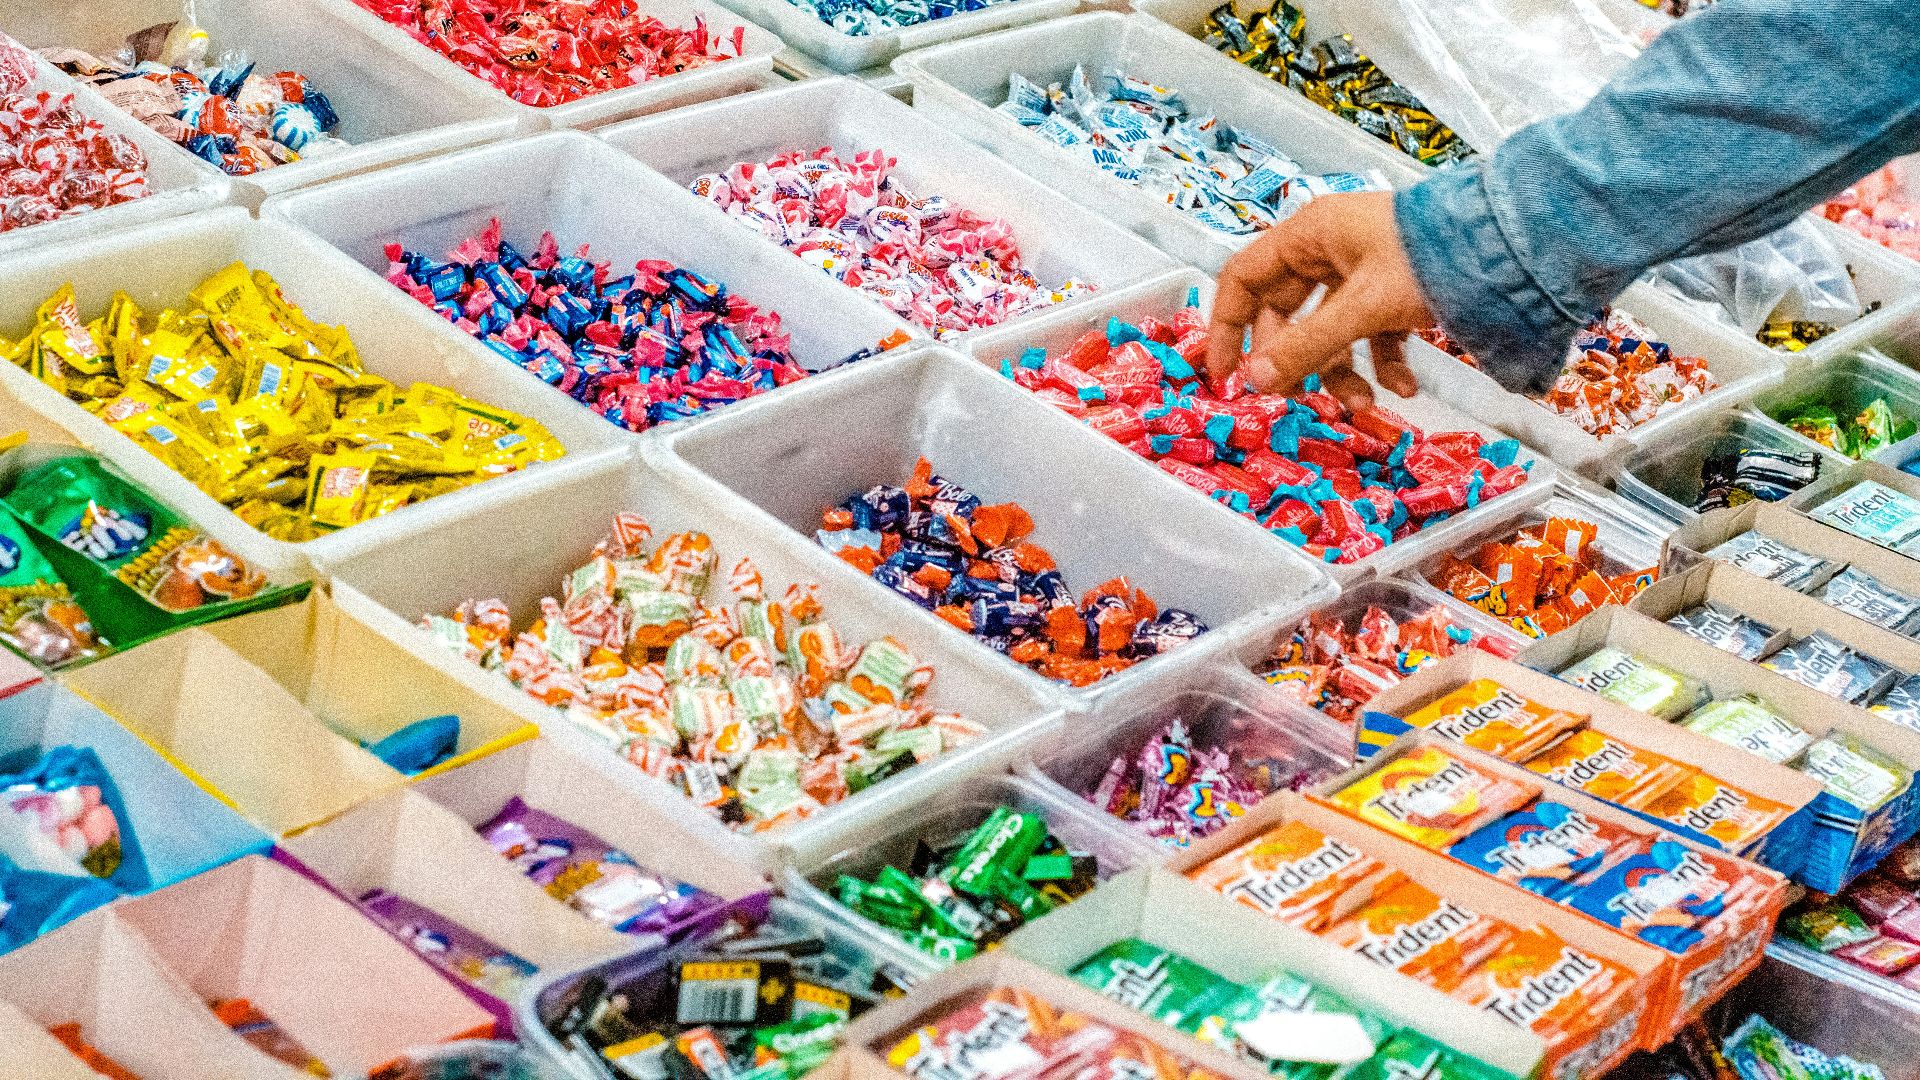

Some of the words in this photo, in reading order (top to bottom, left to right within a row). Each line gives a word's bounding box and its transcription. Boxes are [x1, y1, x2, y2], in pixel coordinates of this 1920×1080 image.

[1115, 128, 1151, 143] Milk
[1827, 487, 1897, 527] Trident
[1586, 654, 1643, 692] ident
[1428, 689, 1524, 742] Trident
[1687, 786, 1746, 830] dent
[1230, 838, 1357, 909] Trident
[1355, 901, 1474, 967] Trident
[1481, 950, 1598, 1028] Trident
